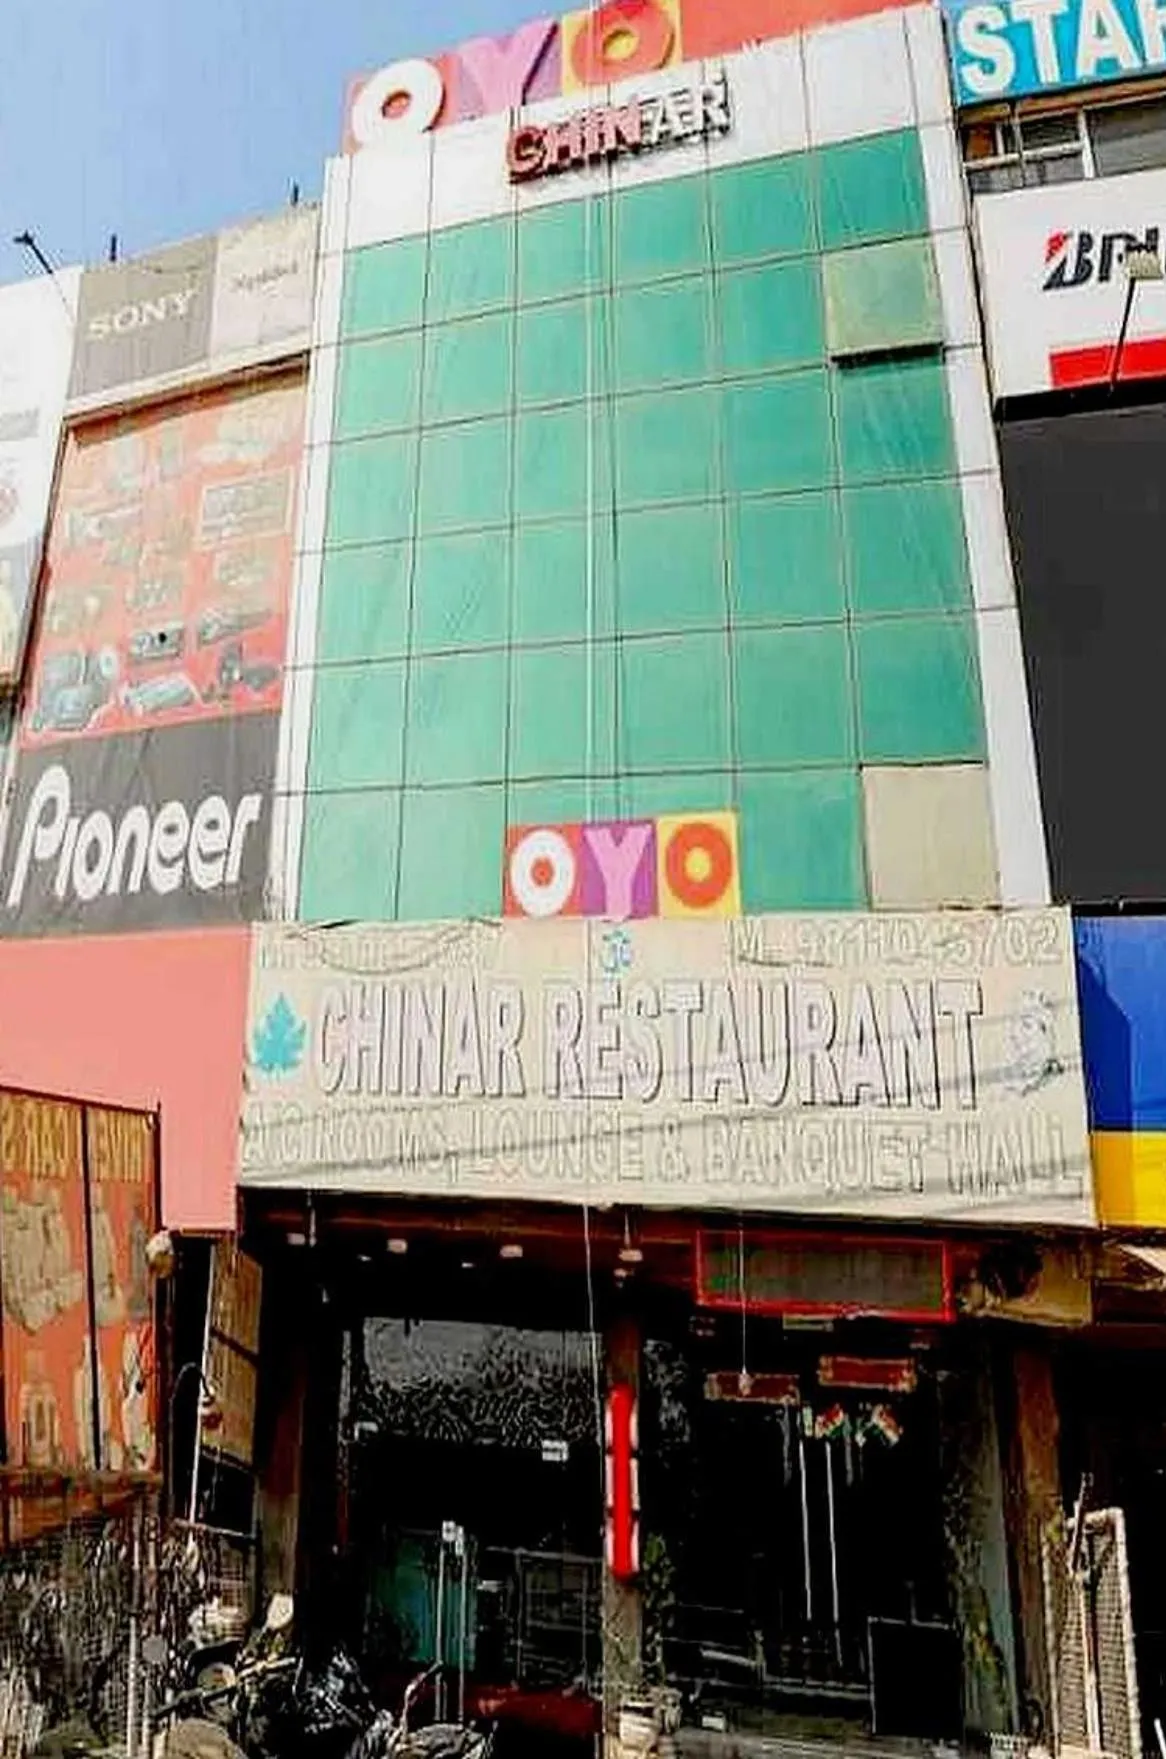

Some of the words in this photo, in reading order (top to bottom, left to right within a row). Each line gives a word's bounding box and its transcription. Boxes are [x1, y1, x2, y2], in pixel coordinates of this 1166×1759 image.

[351, 0, 676, 154] OYO
[89, 287, 198, 338] SONY
[7, 765, 262, 908] Pioneer
[510, 820, 732, 922] OYO
[320, 970, 527, 1098] CHINAR
[541, 975, 984, 1112] RESTAURANT
[467, 1107, 645, 1184] LOUNGE
[702, 1113, 926, 1196] BANQUET
[943, 1115, 1086, 1202] HALL
